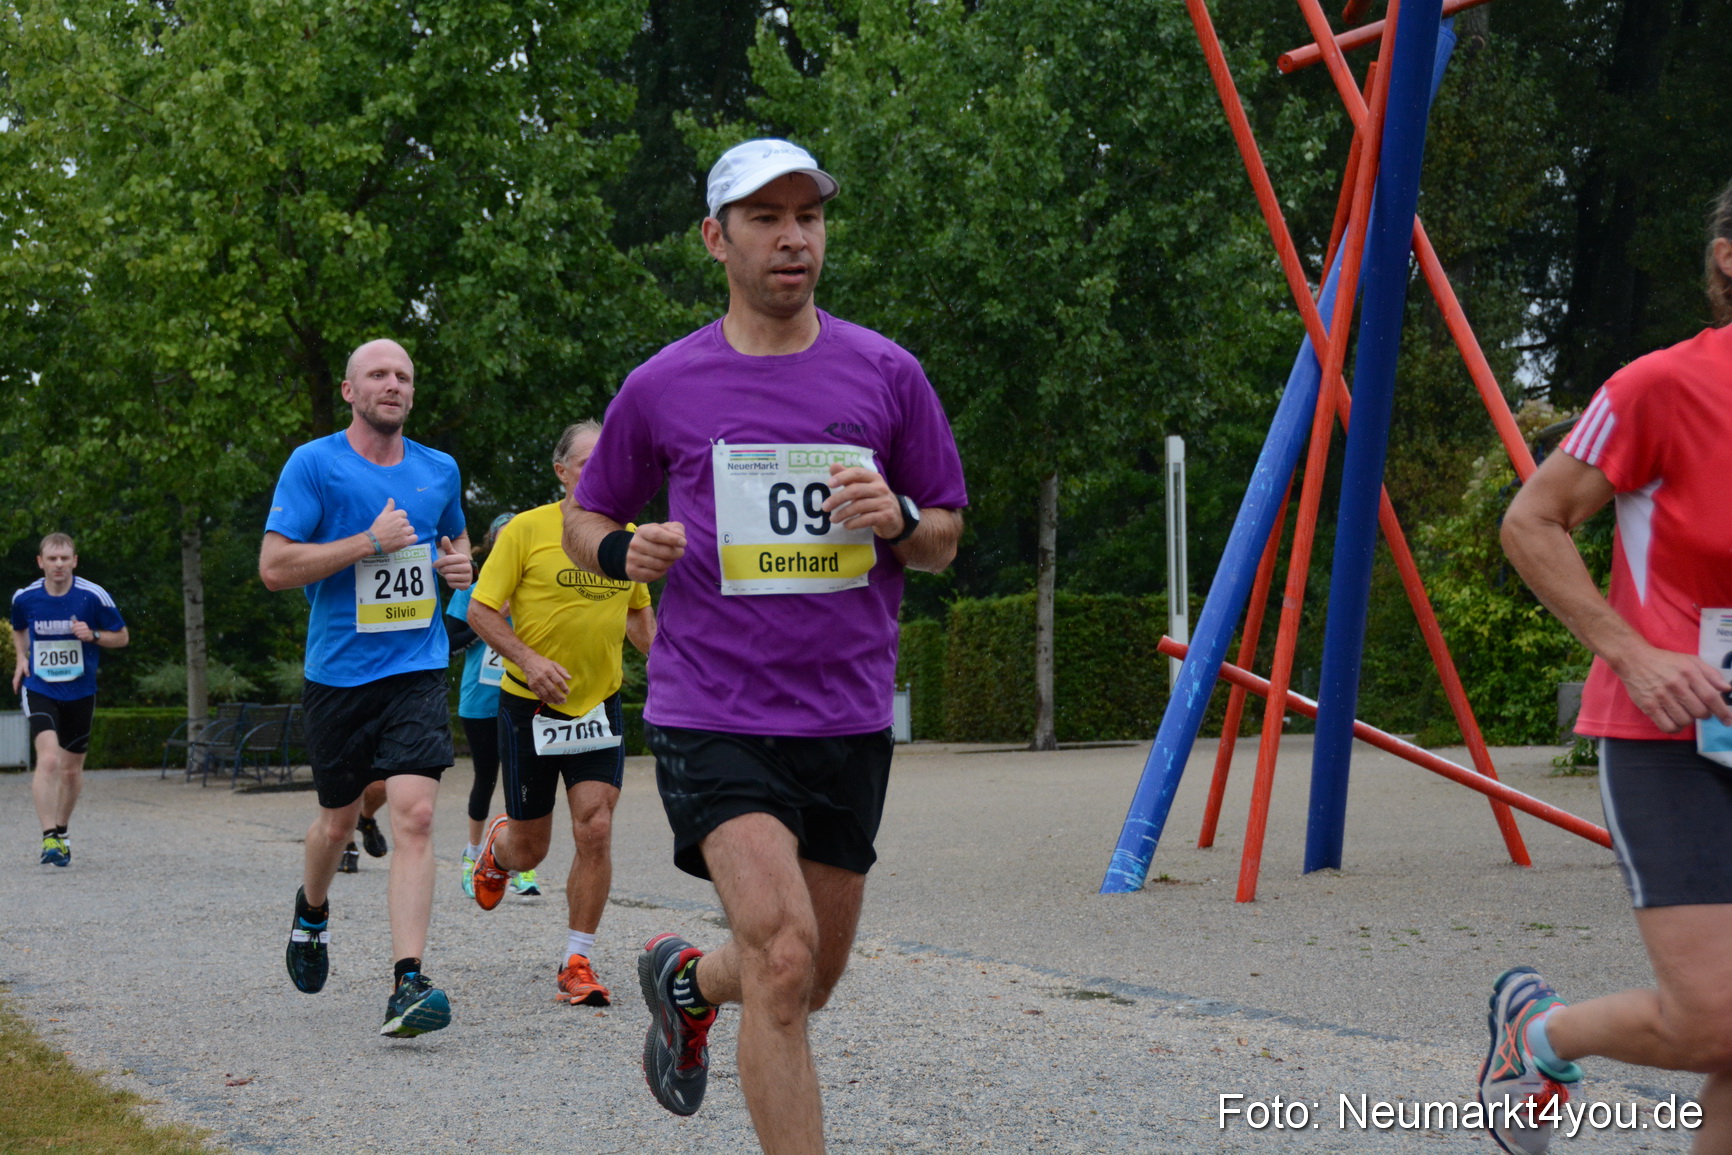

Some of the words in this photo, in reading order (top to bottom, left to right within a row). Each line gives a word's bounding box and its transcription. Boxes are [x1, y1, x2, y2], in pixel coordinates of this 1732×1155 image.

[728, 462, 779, 470] NeuerMarkt
[788, 450, 863, 468] BOCK
[768, 482, 831, 536] 69
[759, 551, 839, 573] Gerhard
[374, 566, 424, 599] 248
[385, 606, 416, 619] Silvio
[40, 650, 78, 666] 2050
